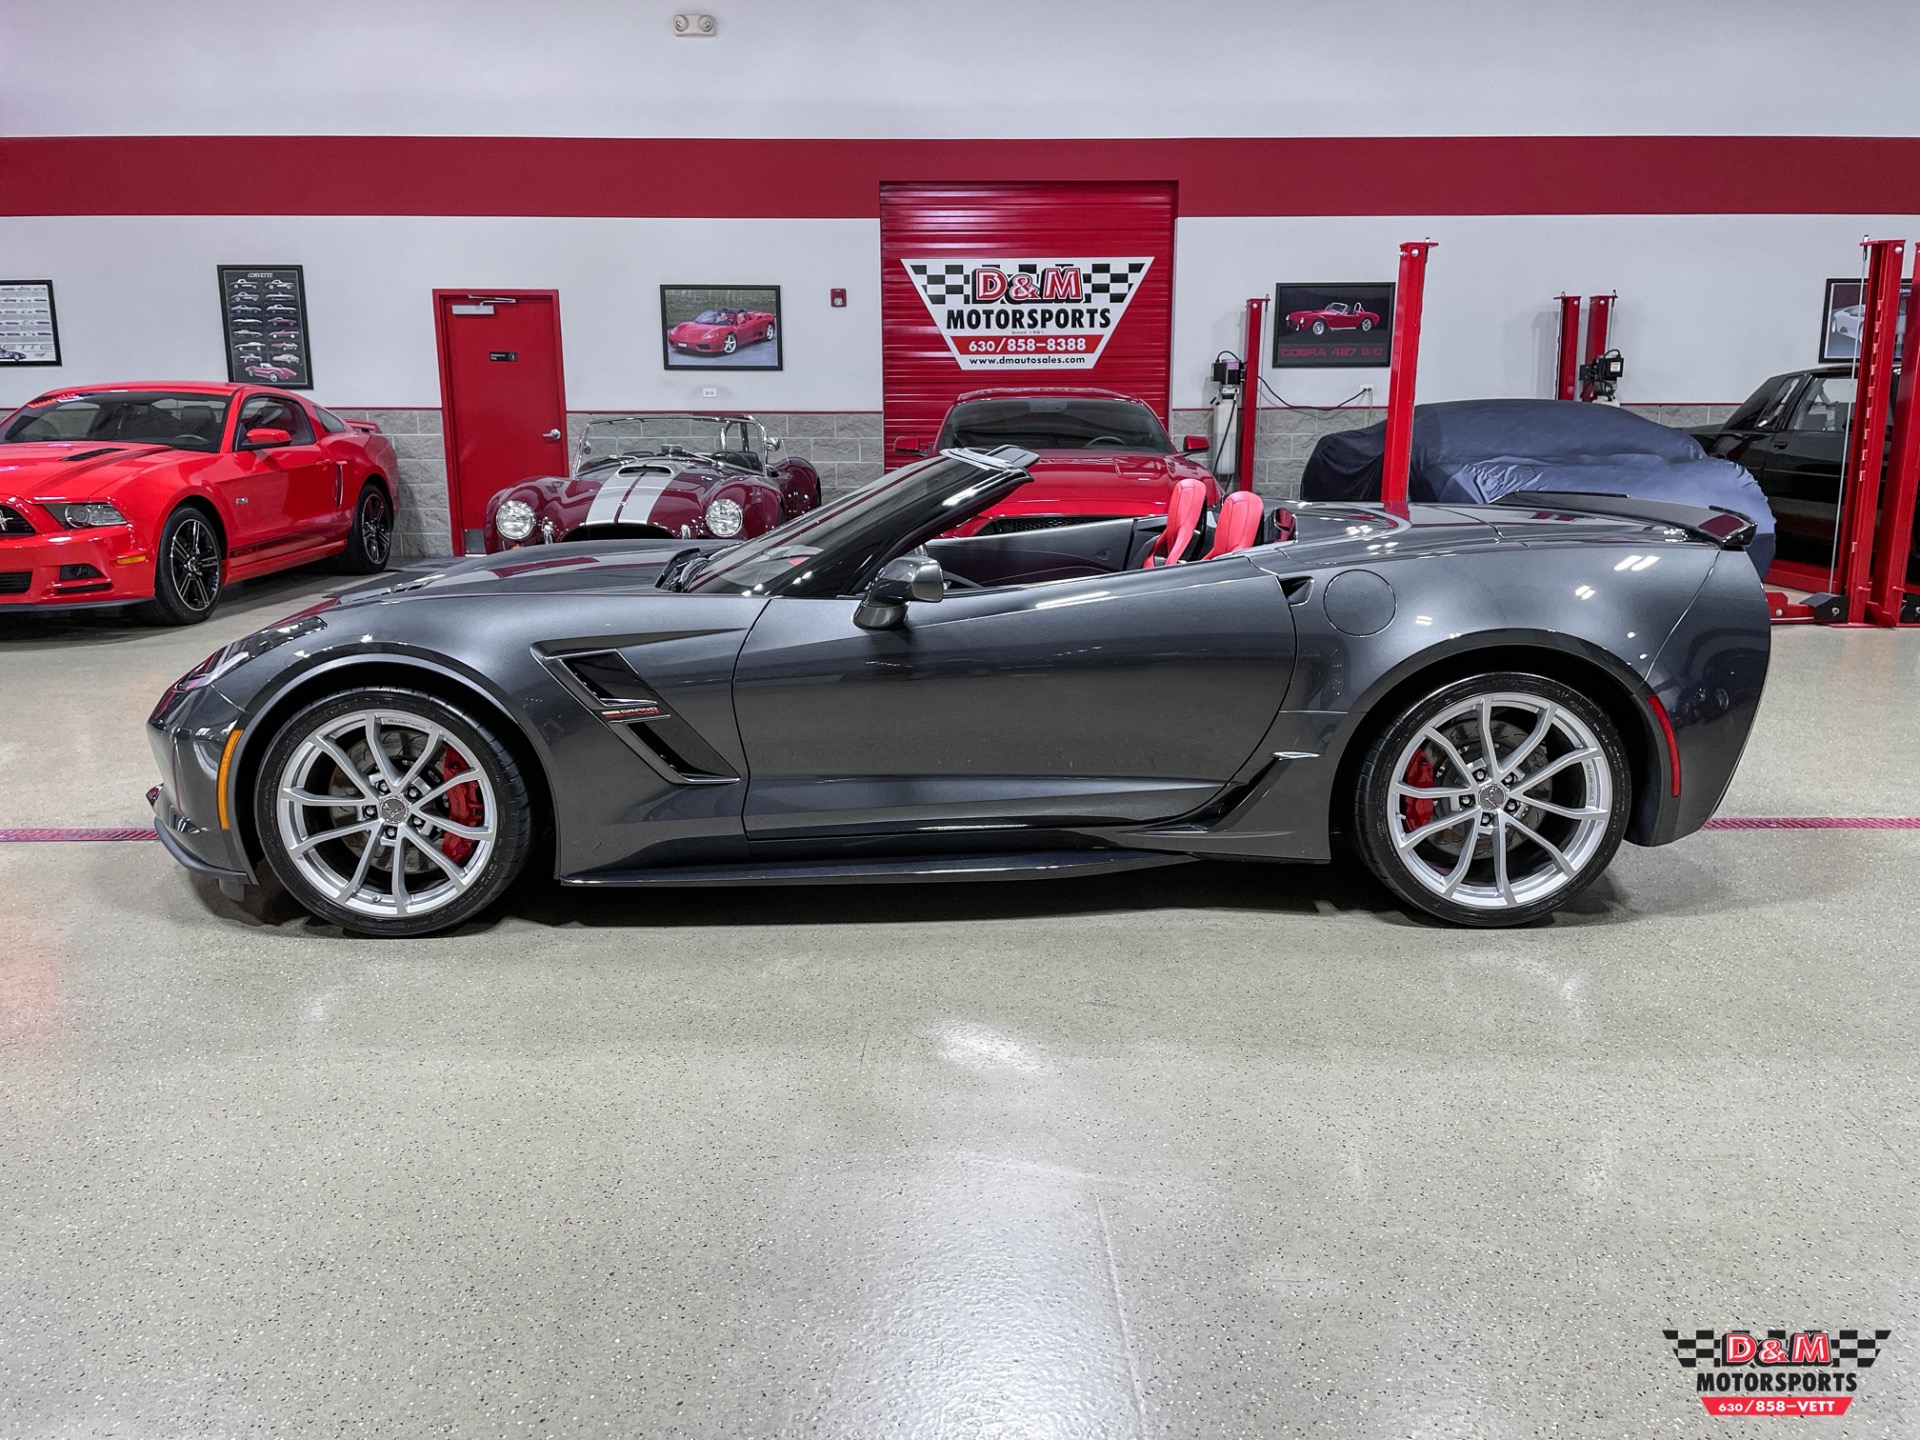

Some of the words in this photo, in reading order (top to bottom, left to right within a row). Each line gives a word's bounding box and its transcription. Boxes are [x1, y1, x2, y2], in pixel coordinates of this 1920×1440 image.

[973, 267, 1083, 303] D&M
[947, 308, 1111, 329] MOTORSPORTS
[969, 337, 1086, 353] 630/858-8388
[1281, 348, 1326, 357] COBRA
[1331, 348, 1358, 356] 427
[969, 355, 1086, 365] www.dmautosales.com
